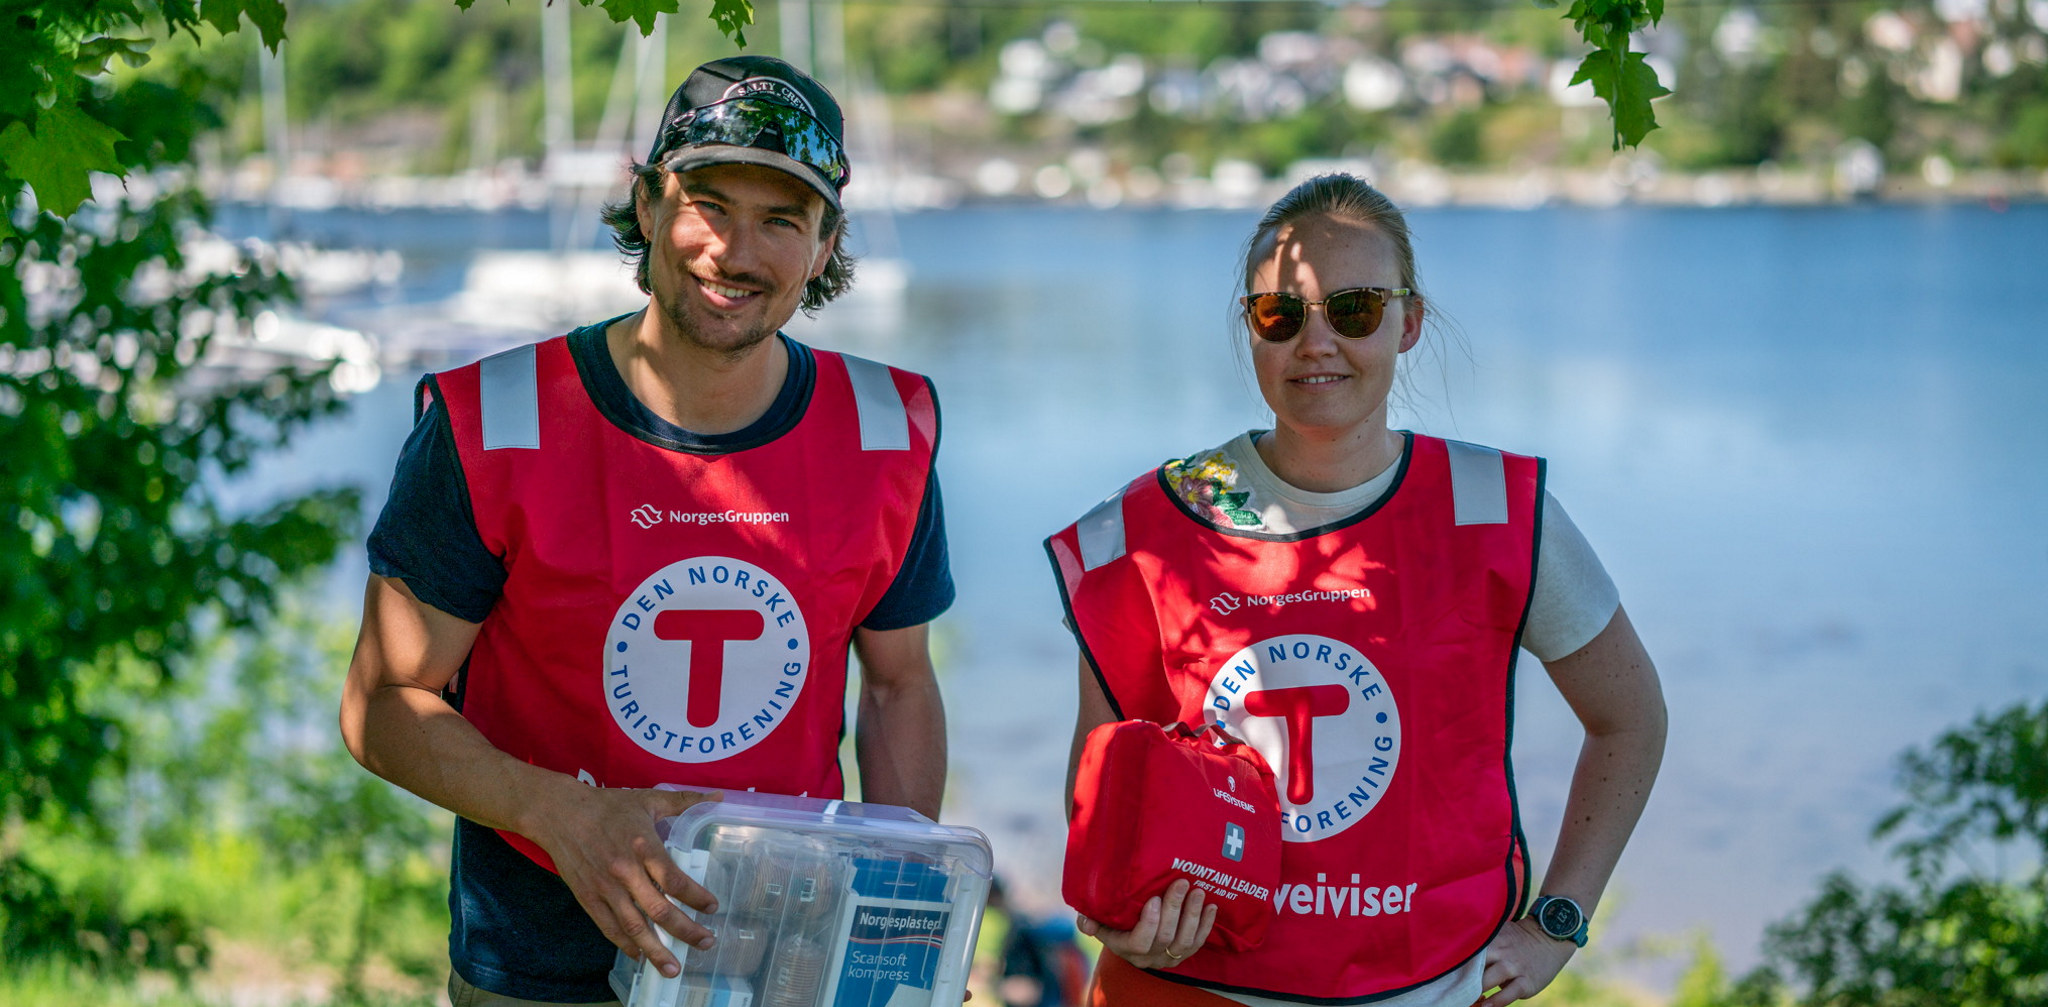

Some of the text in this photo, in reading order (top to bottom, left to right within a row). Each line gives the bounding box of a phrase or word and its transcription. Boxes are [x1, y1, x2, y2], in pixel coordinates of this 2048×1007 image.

[737, 81, 776, 97] SALTY
[781, 87, 808, 112] CREW
[669, 509, 790, 526] NorgesGruppen
[621, 565, 795, 631] DEN NORSKE
[1246, 587, 1371, 607] NorgesGruppen
[653, 609, 765, 729] T
[1213, 641, 1382, 712] DEN NORSKE
[610, 661, 801, 754] TURISTFORENING
[1243, 683, 1351, 806] T
[1280, 735, 1394, 834] FORENING
[1171, 857, 1270, 902] MOUNTAIN LEADER
[1193, 879, 1239, 901] FIRST AID KIT
[859, 911, 943, 931] Norgesplaster
[847, 964, 910, 983] kompress
[851, 950, 908, 967] Scansoft
